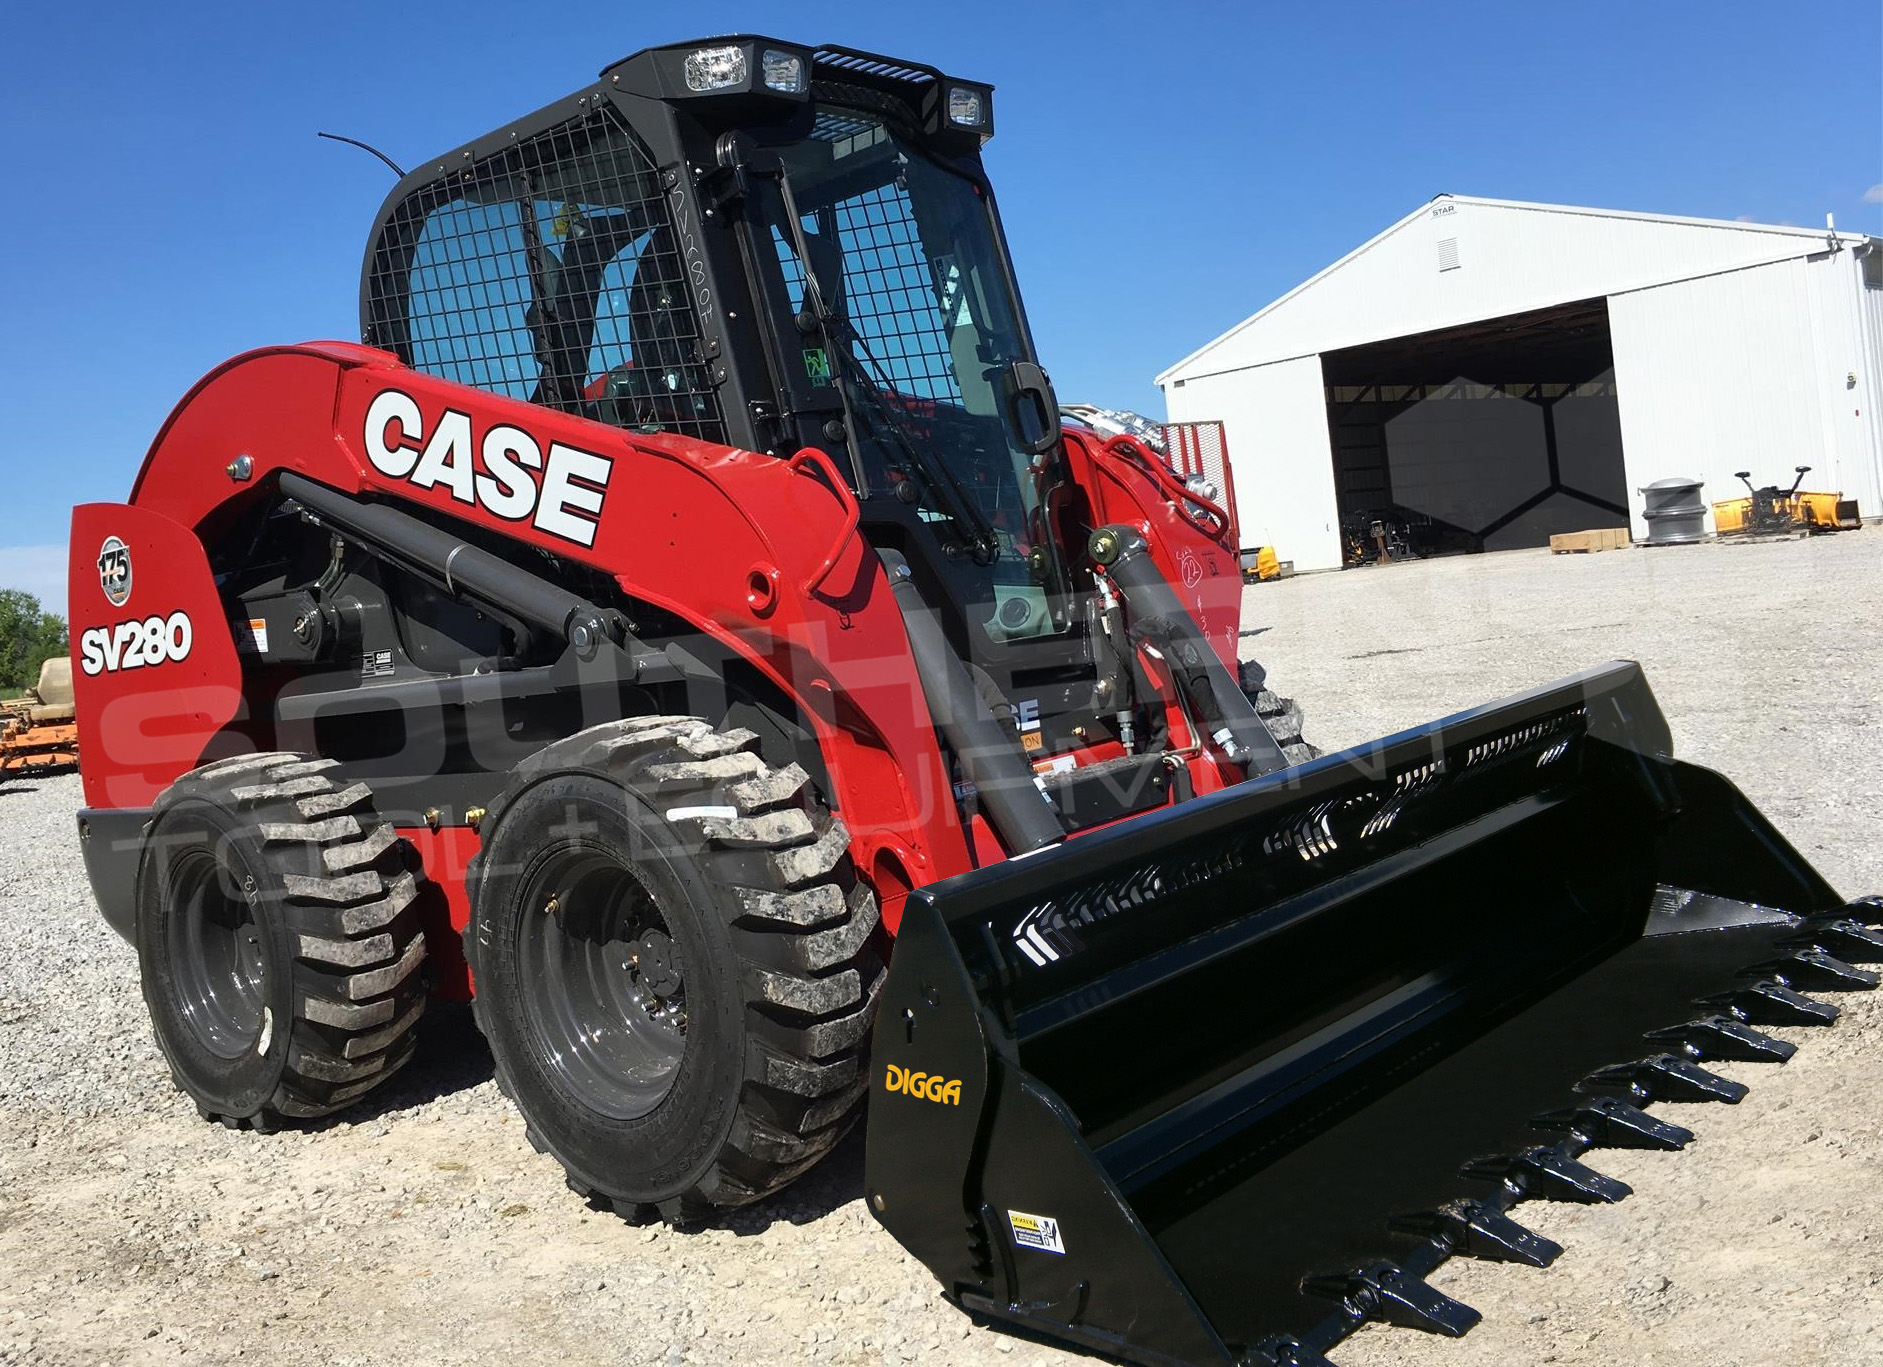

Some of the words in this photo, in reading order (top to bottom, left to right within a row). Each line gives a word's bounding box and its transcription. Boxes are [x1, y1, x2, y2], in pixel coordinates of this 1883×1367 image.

[1432, 205, 1455, 217] STAR
[364, 388, 615, 549] CASE
[80, 610, 193, 677] SV280
[376, 651, 391, 660] CASE
[885, 1063, 963, 1106] DIGGA
